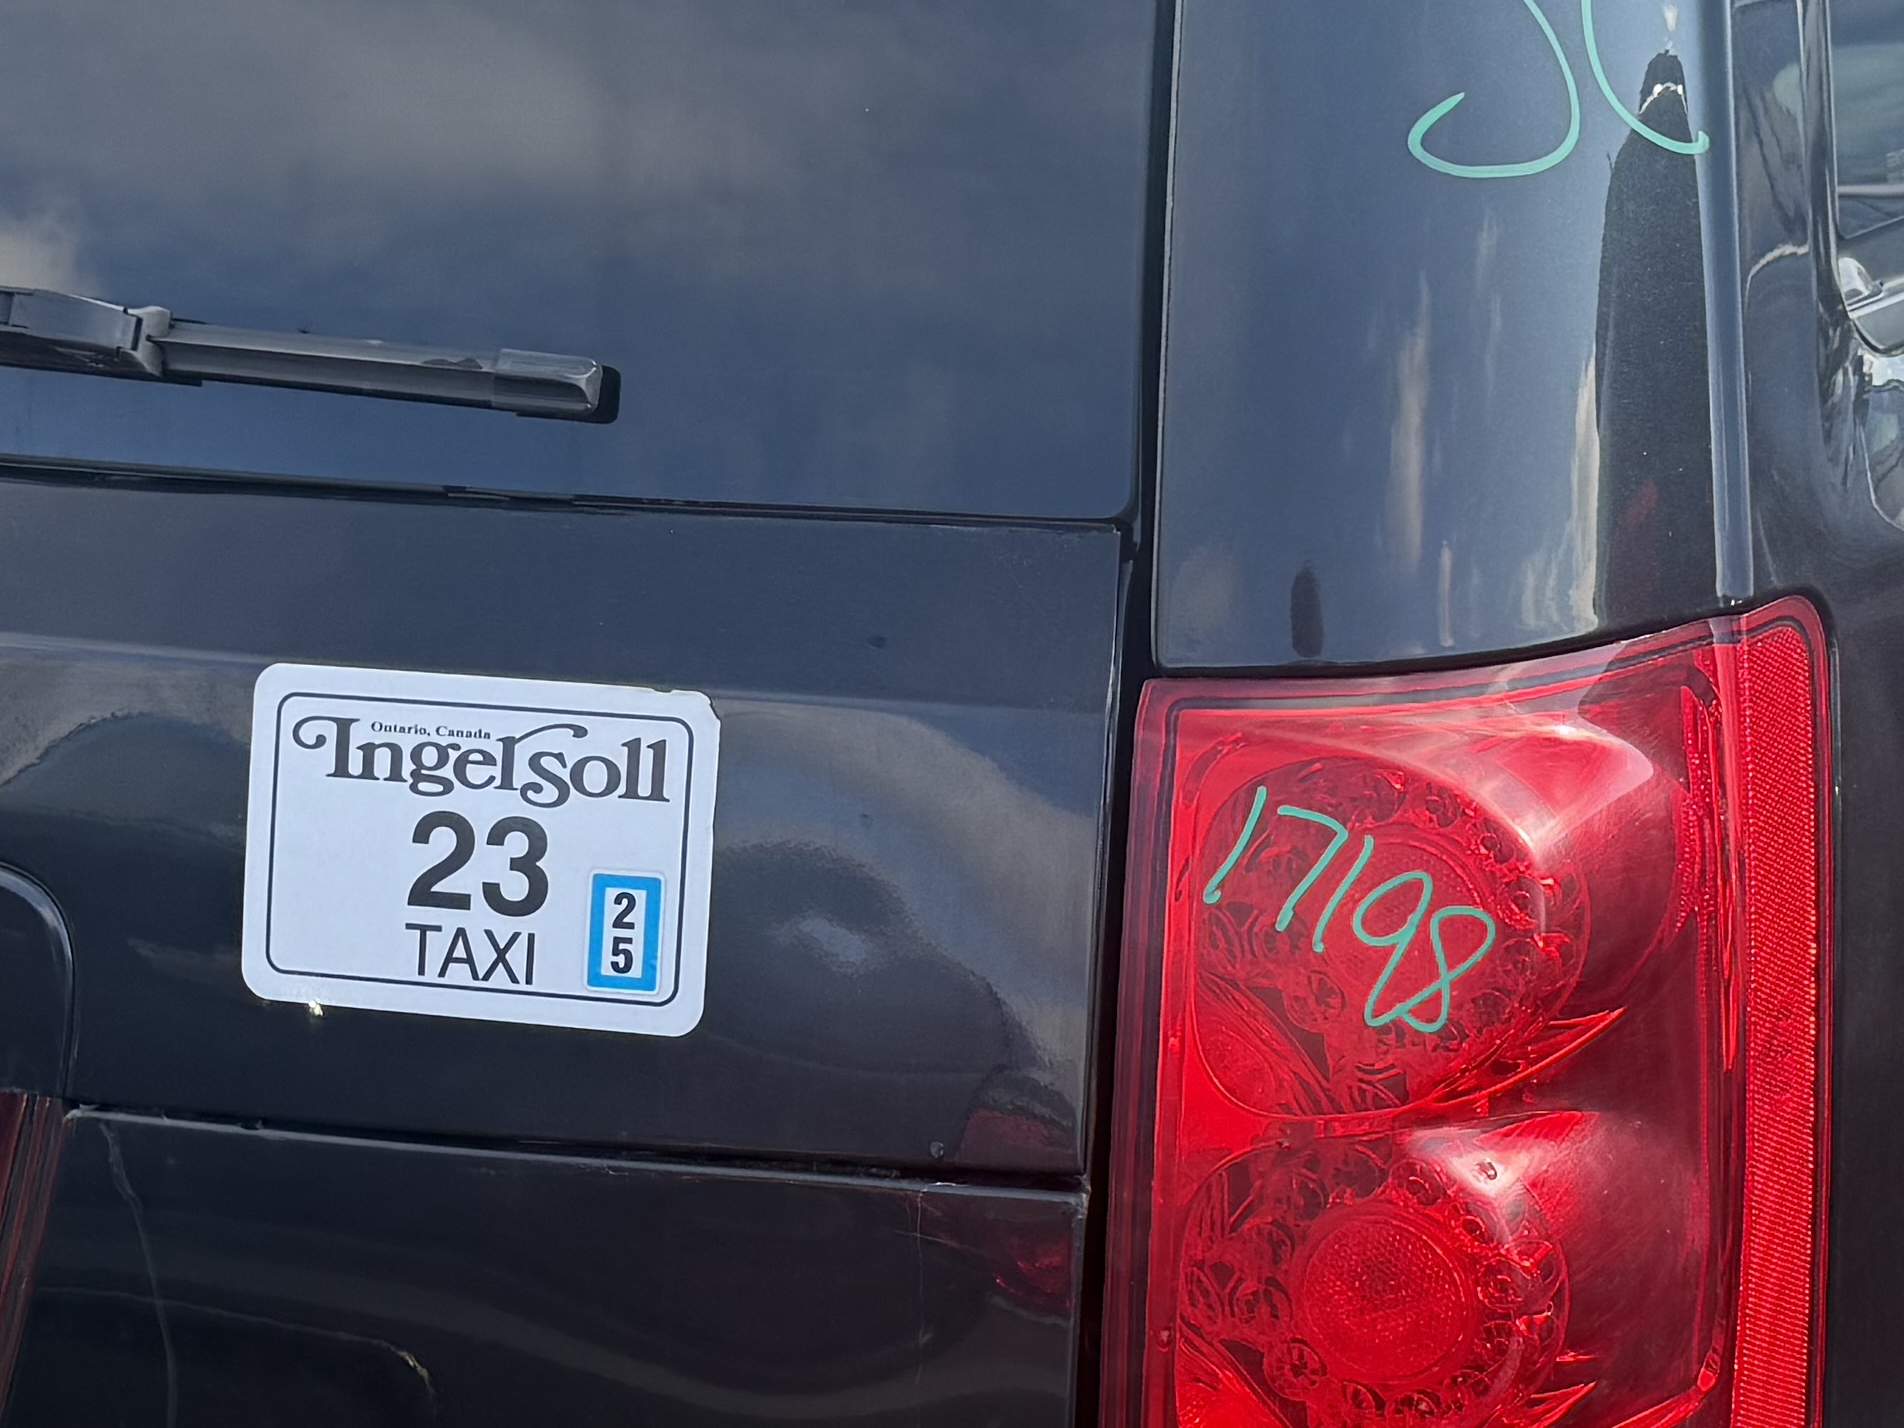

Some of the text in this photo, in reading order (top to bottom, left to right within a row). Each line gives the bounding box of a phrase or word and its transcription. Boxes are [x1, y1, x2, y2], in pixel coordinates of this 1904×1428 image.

[370, 720, 492, 741] Ontario, Canada
[406, 809, 550, 918] 23
[1201, 784, 1496, 1034] 17198
[404, 922, 536, 986] TAXI
